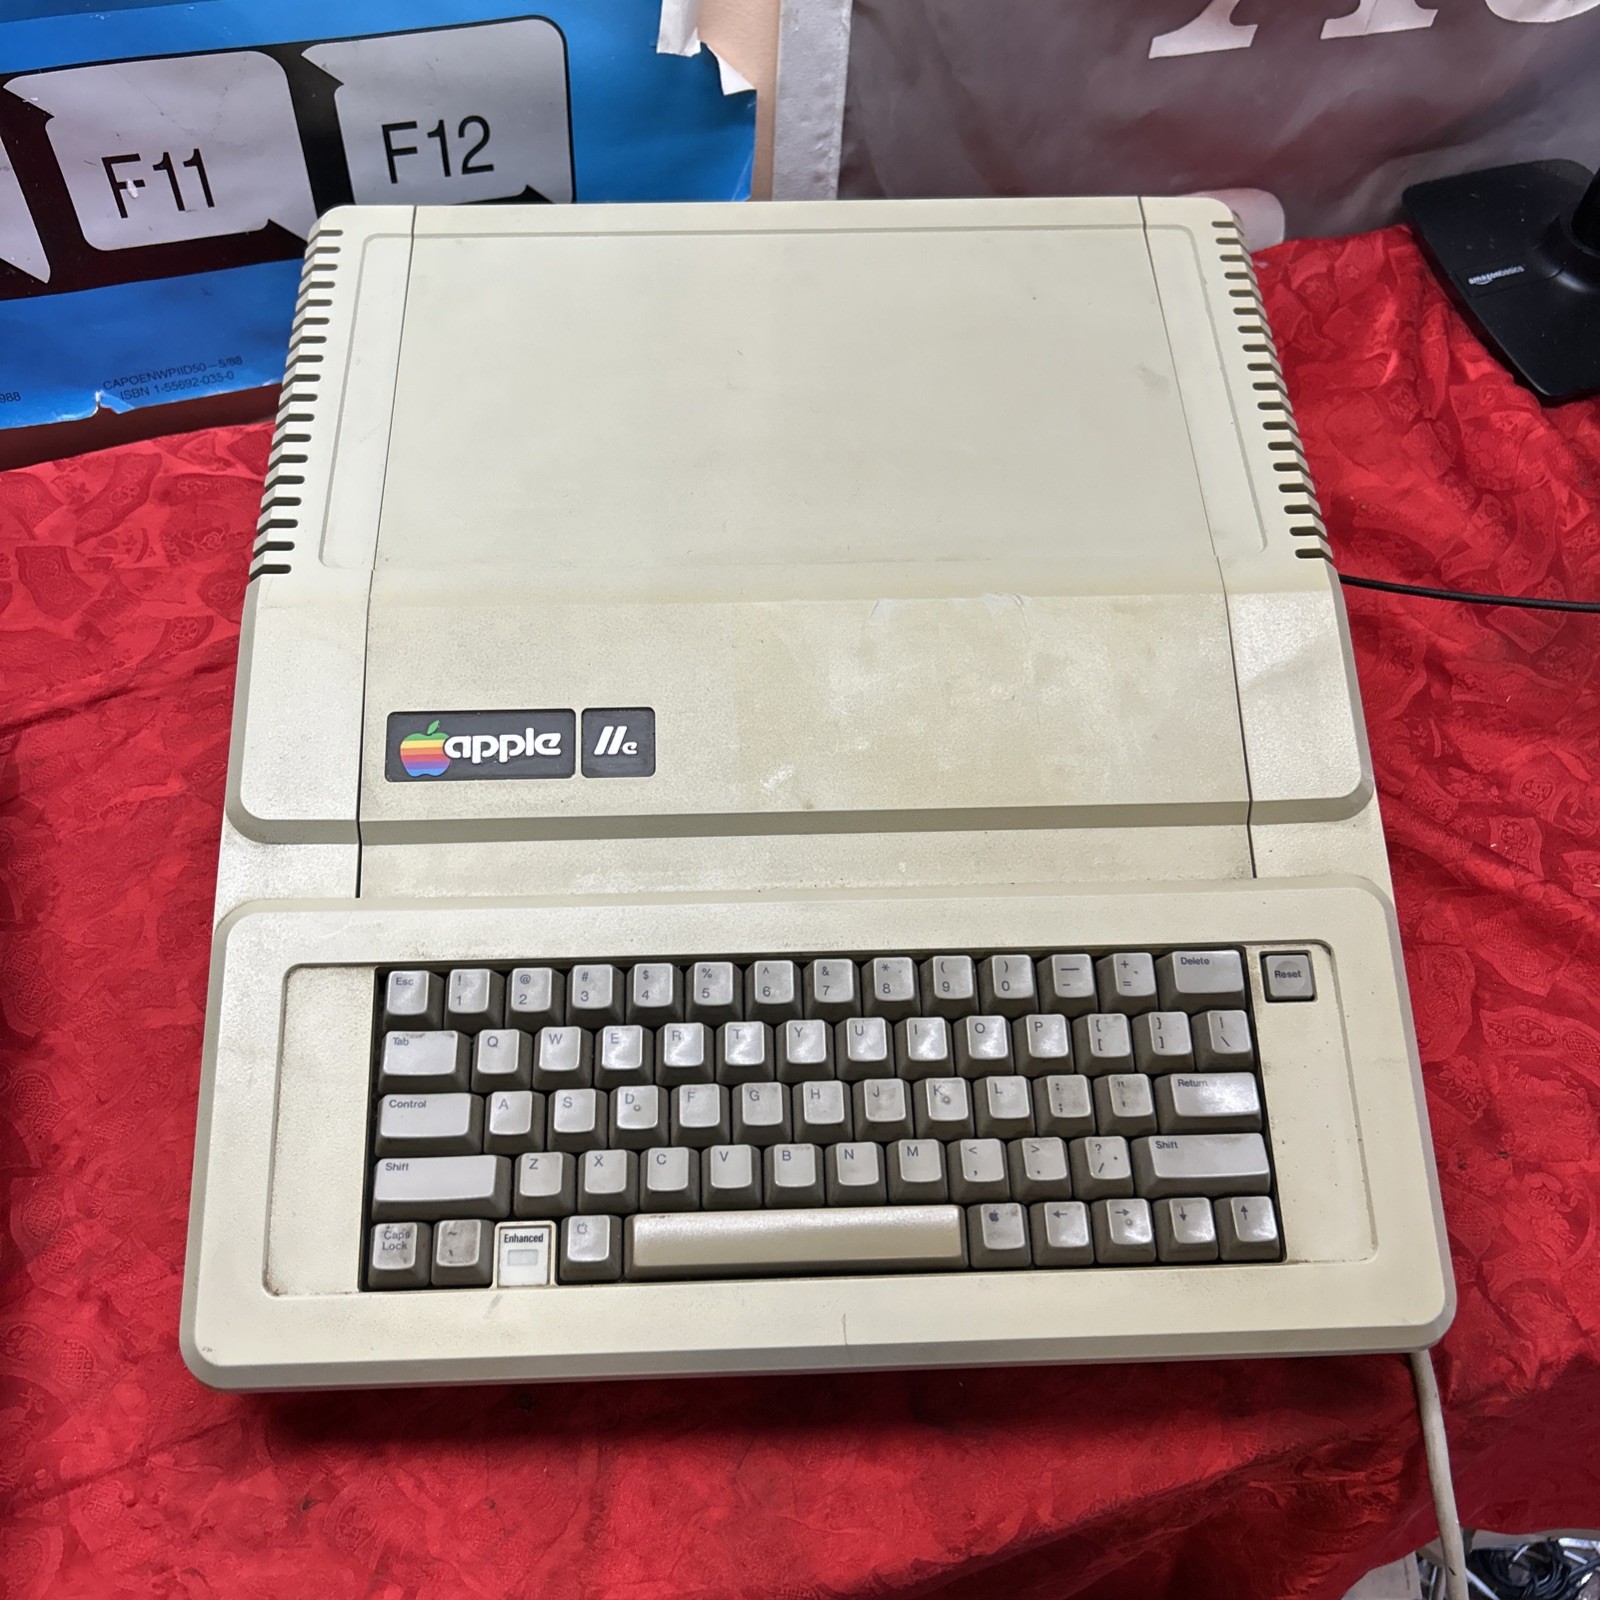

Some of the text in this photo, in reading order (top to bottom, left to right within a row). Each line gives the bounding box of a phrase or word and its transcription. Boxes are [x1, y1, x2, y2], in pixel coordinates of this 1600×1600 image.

[382, 115, 494, 184] F12
[102, 149, 215, 219] F11
[120, 387, 150, 401] ISBN
[444, 727, 561, 764] apple
[1180, 956, 1210, 966] Delete
[1274, 969, 1302, 980] Reset
[395, 976, 414, 986] Esc
[941, 981, 951, 993] 9
[1001, 980, 1010, 992] 0
[702, 987, 711, 999] 5
[763, 986, 771, 998] 6
[822, 985, 831, 996] 7
[882, 983, 891, 994] 8
[456, 995, 463, 1006] 1
[518, 994, 528, 1006] 2
[580, 990, 590, 1002] 3
[641, 989, 651, 1001] 4
[794, 1027, 804, 1038] Y
[854, 1025, 865, 1036] U
[974, 1022, 986, 1034] O
[1034, 1022, 1044, 1033] P
[548, 1033, 563, 1045] W
[610, 1032, 620, 1045] E
[672, 1030, 683, 1041] R
[733, 1029, 742, 1040] T
[393, 1037, 410, 1046] Tab
[487, 1036, 499, 1048] Q
[994, 1083, 1004, 1094] L
[1177, 1078, 1208, 1088] Return
[687, 1091, 696, 1103] F
[749, 1089, 760, 1101] G
[810, 1088, 821, 1100] H
[872, 1086, 880, 1098] J
[933, 1085, 943, 1097] K
[389, 1099, 427, 1109] Control
[499, 1098, 509, 1110] A
[562, 1096, 573, 1109] S
[625, 1093, 635, 1105] D
[1155, 1140, 1178, 1150] Shift
[719, 1151, 729, 1163] V
[782, 1150, 792, 1162] B
[844, 1148, 855, 1160] N
[906, 1146, 919, 1158] M
[529, 1158, 539, 1170] Z
[593, 1155, 604, 1168] X
[656, 1153, 667, 1166] C
[385, 1161, 409, 1172] Shift
[383, 1229, 411, 1241] Caps
[504, 1233, 544, 1243] Enhanced
[382, 1241, 408, 1251] Lock
